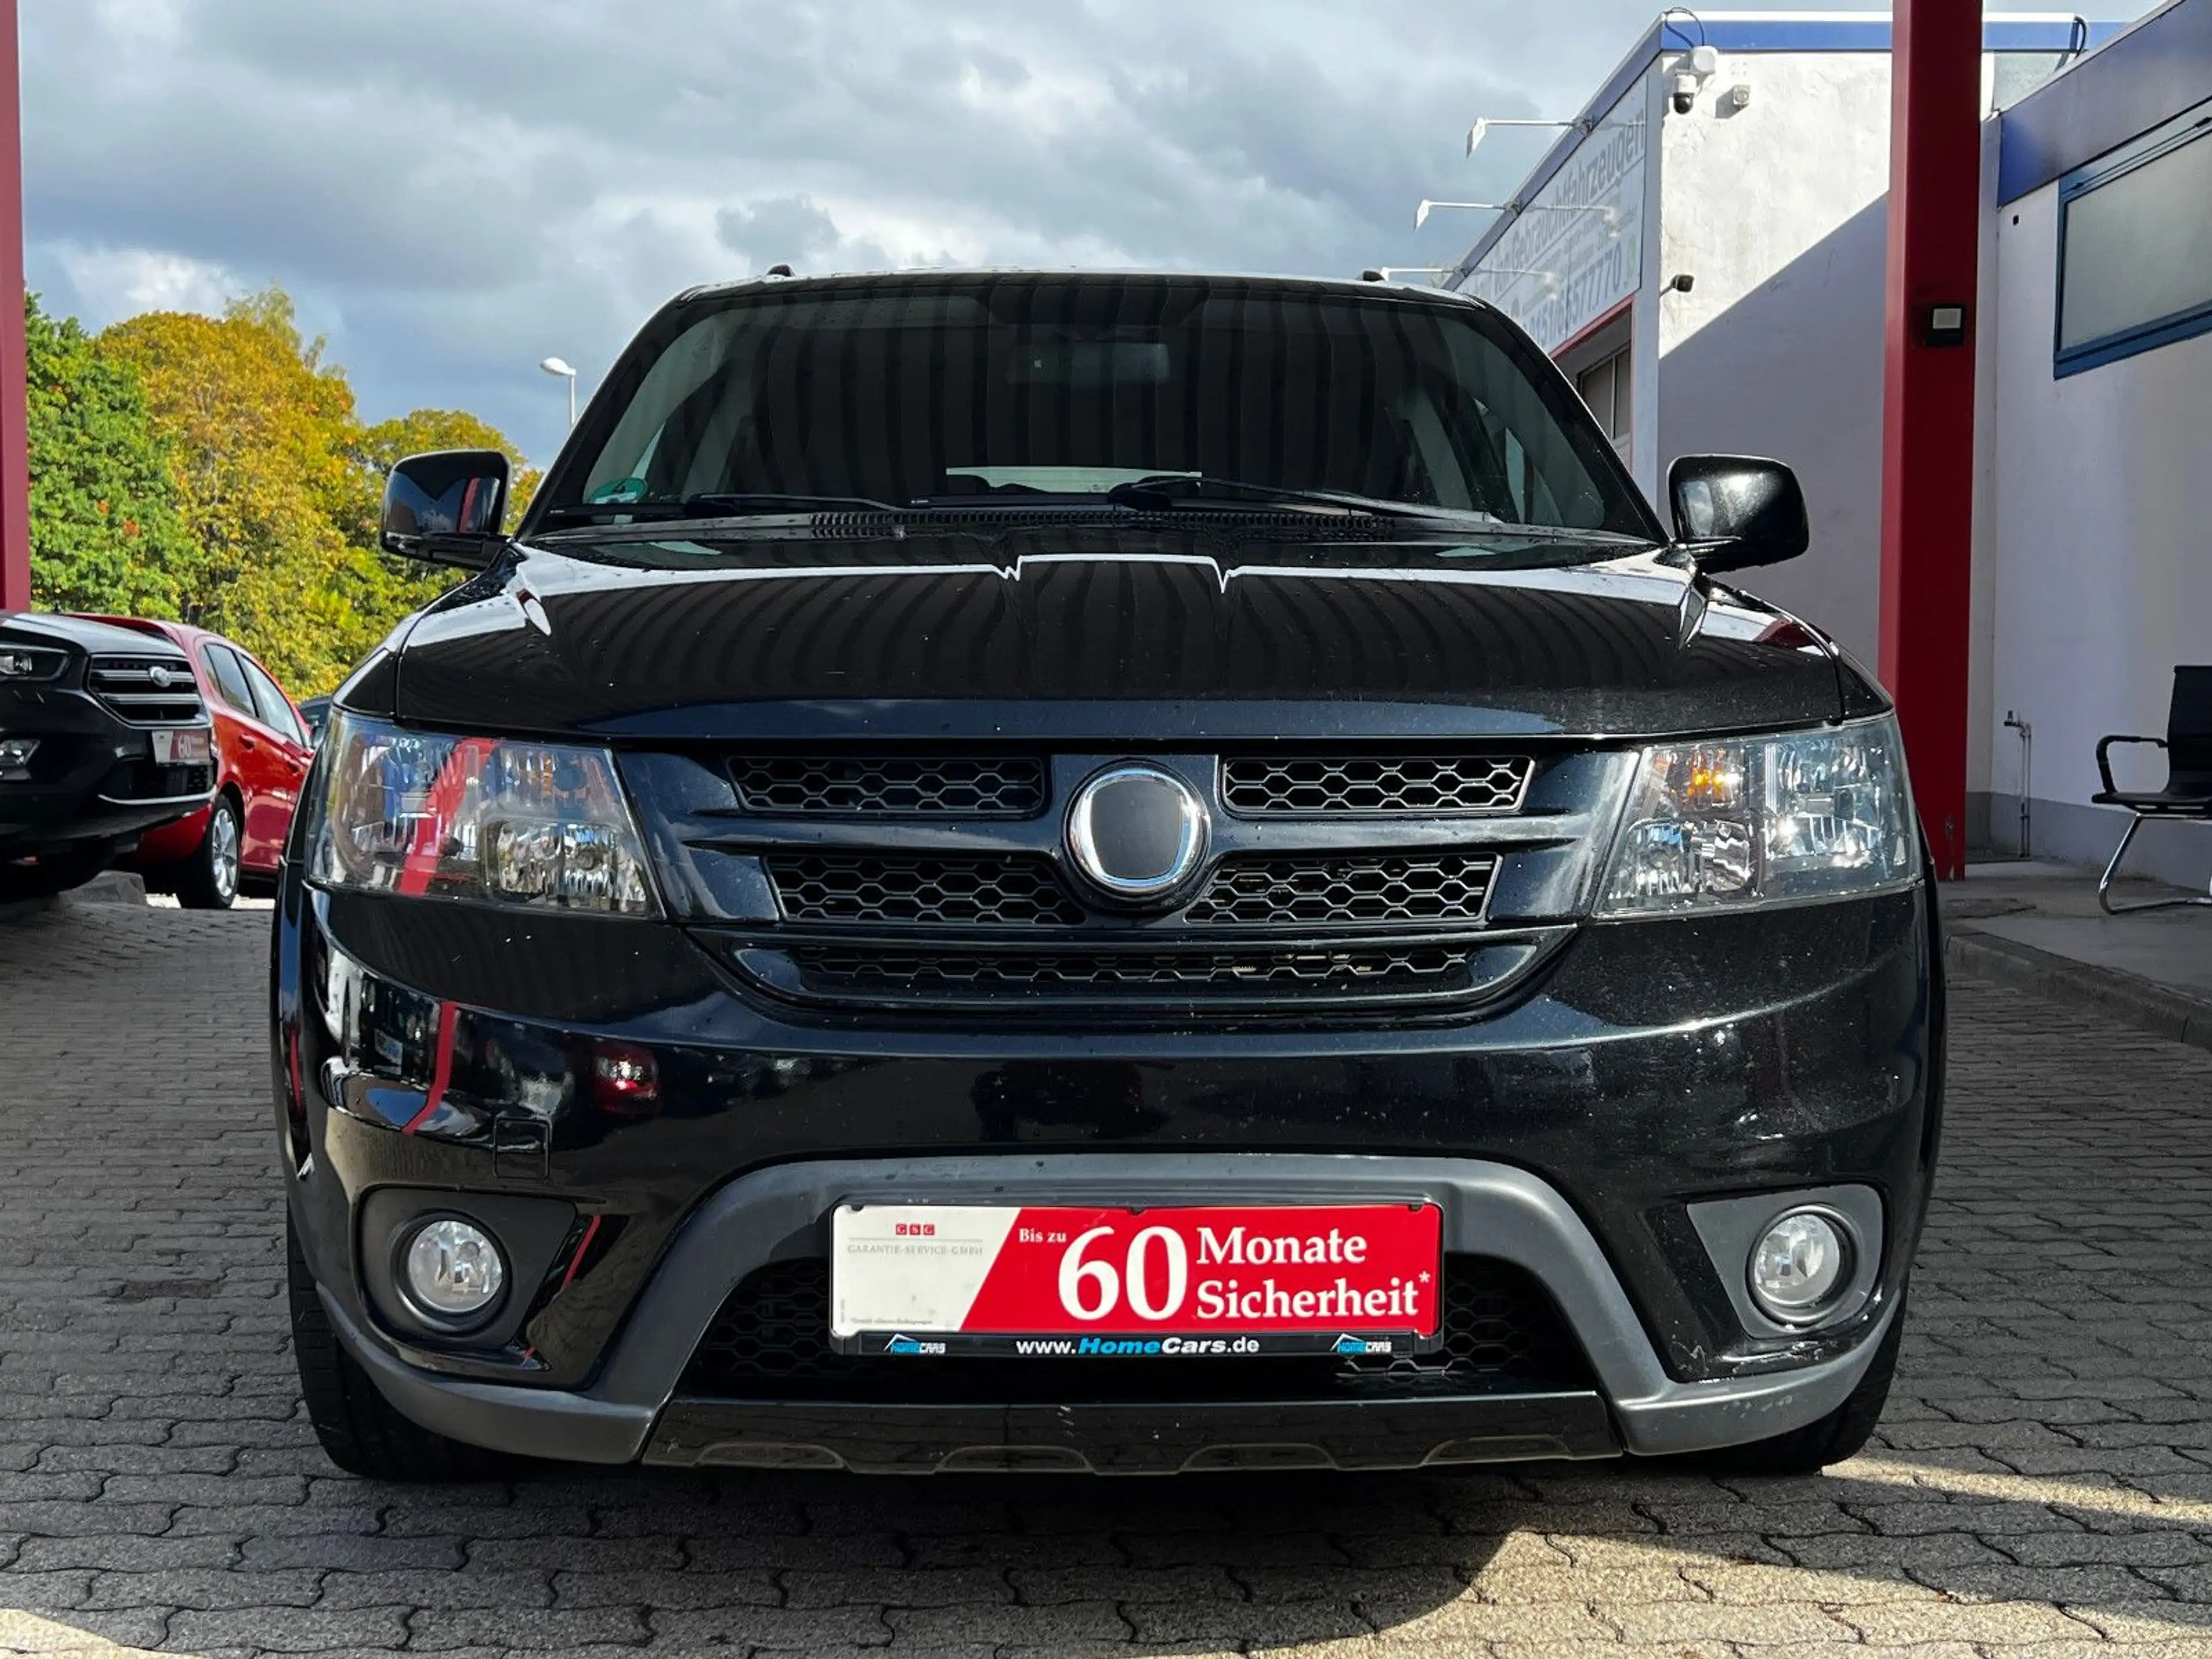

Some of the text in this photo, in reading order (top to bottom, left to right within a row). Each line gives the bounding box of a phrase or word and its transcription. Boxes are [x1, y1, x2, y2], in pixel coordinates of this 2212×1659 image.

[178, 734, 191, 758] 60
[1196, 1227, 1368, 1265] Monate
[1019, 1225, 1188, 1321] Bis zu 60
[1016, 1336, 1261, 1354] www.HomeCars.de
